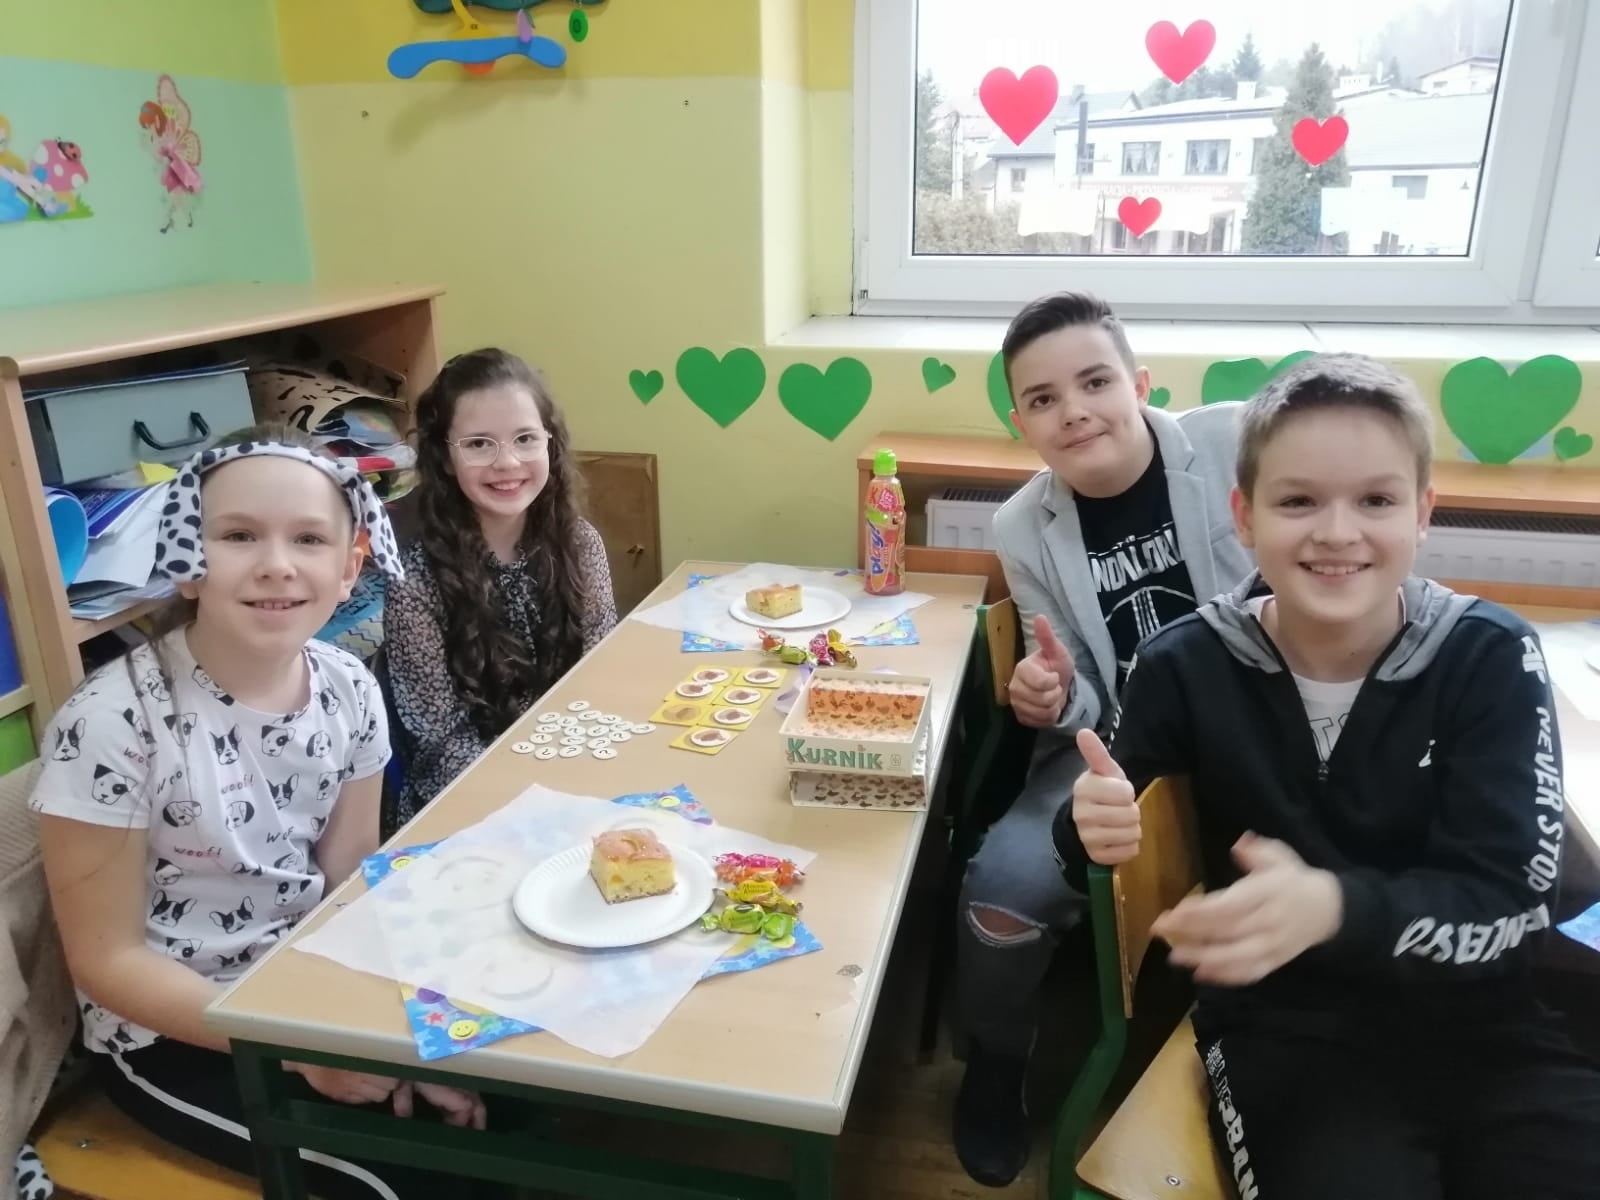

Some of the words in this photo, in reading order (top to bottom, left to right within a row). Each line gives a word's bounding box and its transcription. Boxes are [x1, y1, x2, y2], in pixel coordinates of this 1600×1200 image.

[787, 737, 882, 770] KURNIK
[1534, 706, 1564, 812] NEVER
[1522, 814, 1563, 892] STOP
